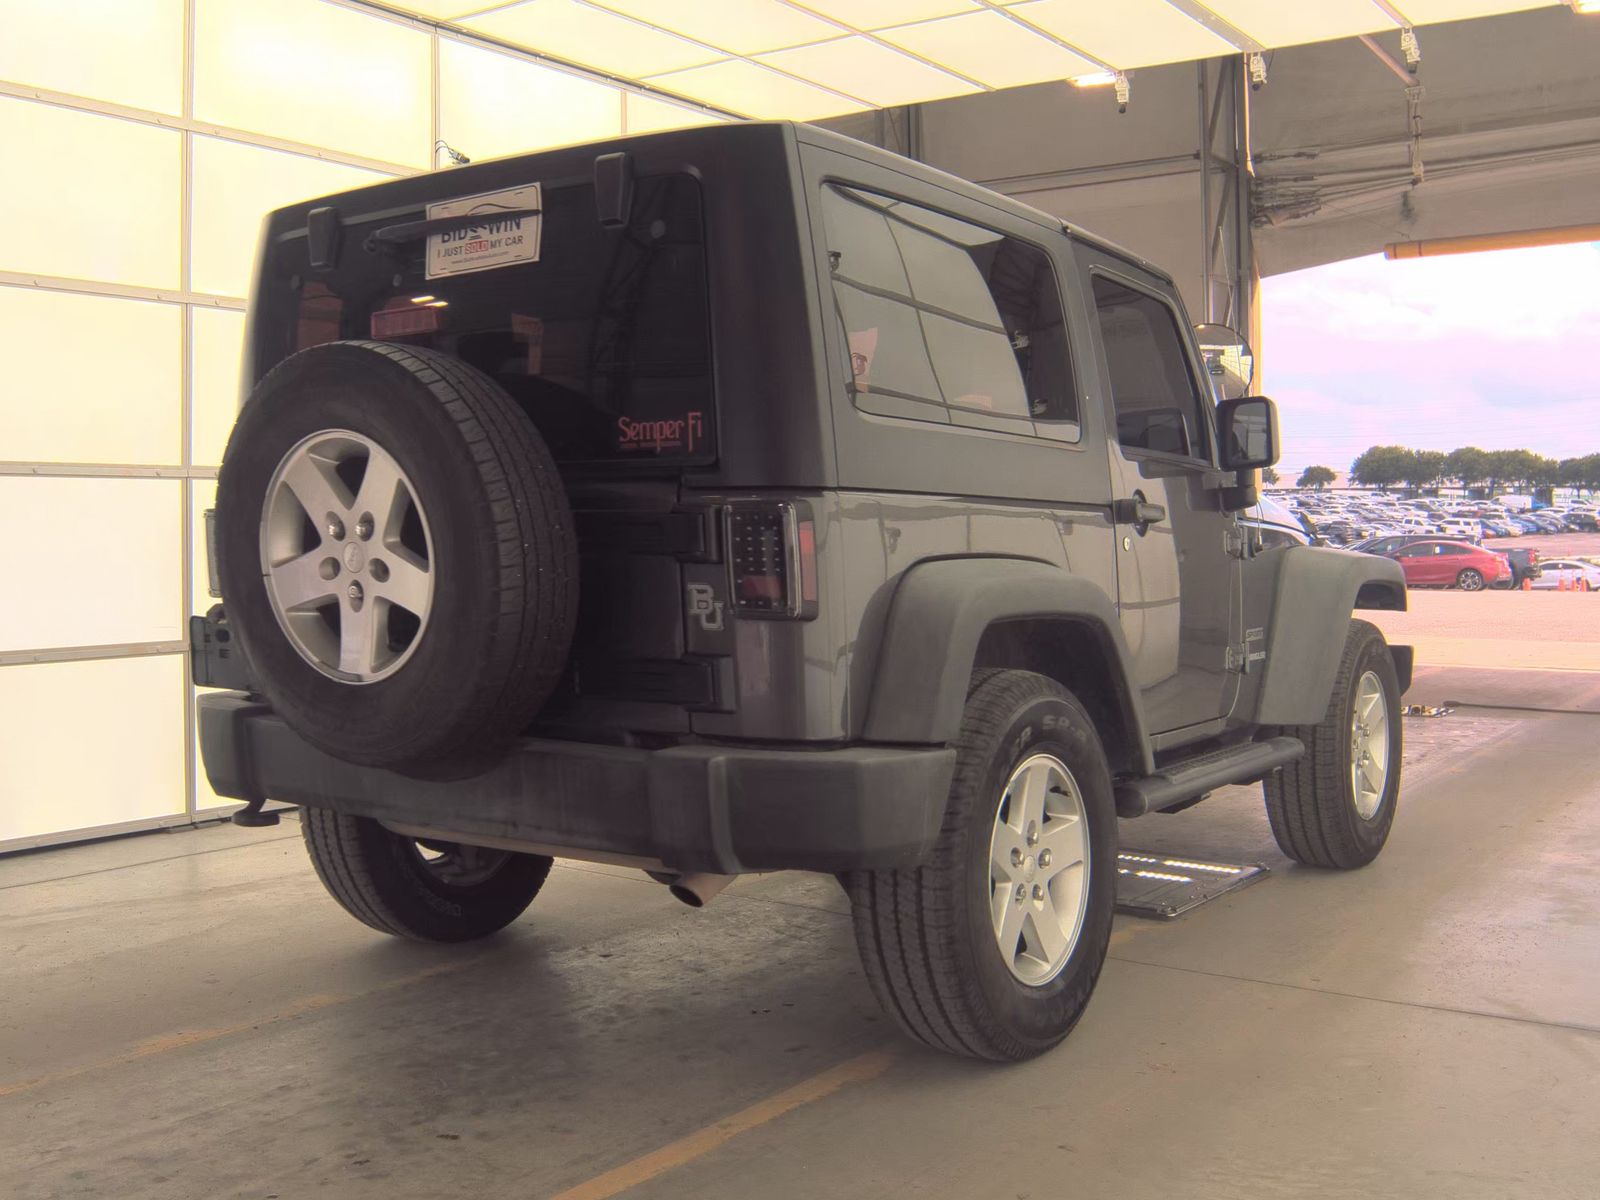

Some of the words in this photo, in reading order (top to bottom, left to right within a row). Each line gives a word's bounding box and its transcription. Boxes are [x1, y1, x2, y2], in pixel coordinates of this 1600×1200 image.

[442, 246, 464, 258] JUST
[465, 240, 488, 254] SOLD
[490, 239, 503, 249] MY
[504, 235, 524, 246] CAR
[618, 416, 685, 454] Semper
[687, 412, 702, 452] Fi
